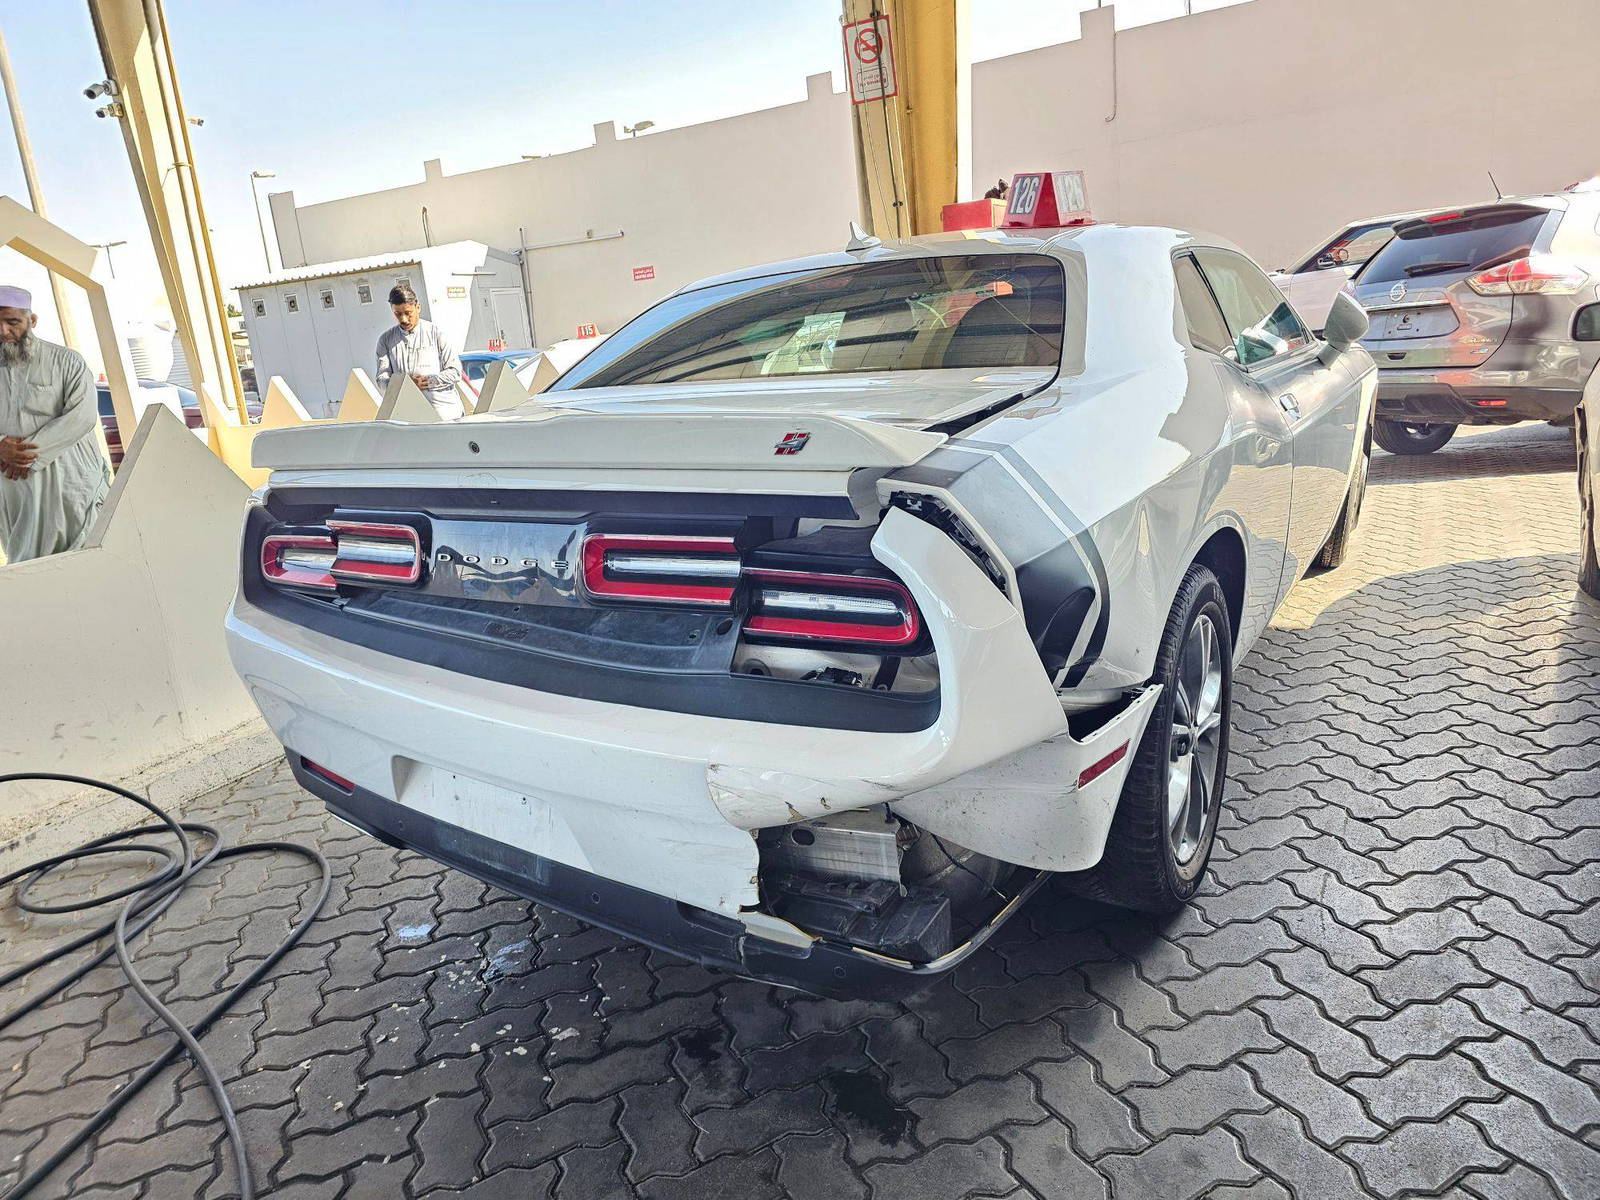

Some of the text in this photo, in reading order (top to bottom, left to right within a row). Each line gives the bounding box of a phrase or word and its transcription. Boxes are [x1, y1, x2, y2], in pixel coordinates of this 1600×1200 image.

[1010, 177, 1040, 214] 126
[581, 324, 593, 336] 115
[437, 553, 569, 570] DODGE
